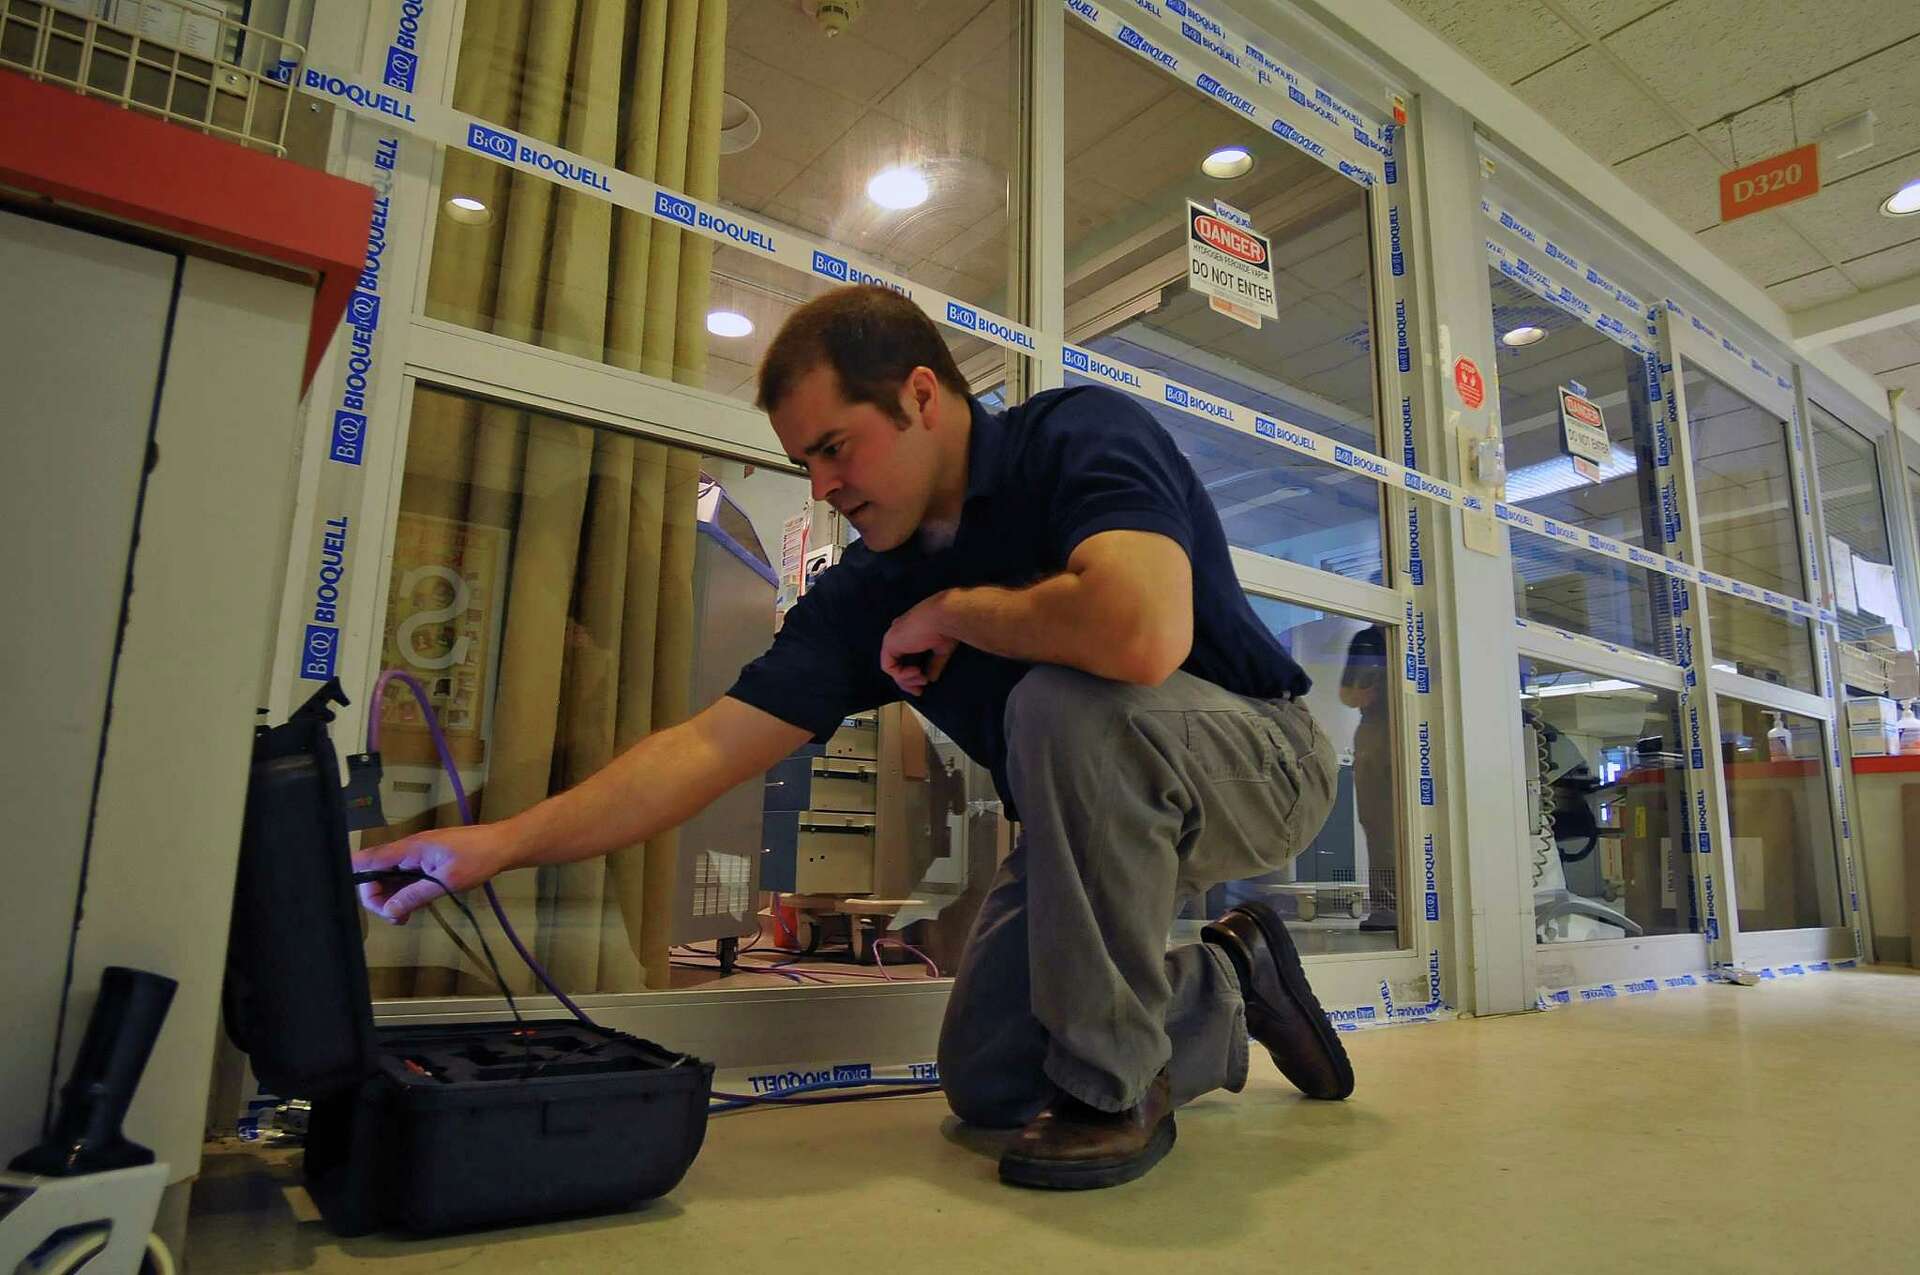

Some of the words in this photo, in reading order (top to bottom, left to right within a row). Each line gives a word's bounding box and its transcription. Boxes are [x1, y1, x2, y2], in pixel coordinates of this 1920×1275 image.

[396, 0, 425, 51] BIOQ
[1202, 37, 1241, 68] BIOQUELL
[306, 68, 417, 123] BIOQUELL
[1217, 85, 1257, 117] BIOQUELL
[1290, 126, 1326, 158] BIOQUELL
[520, 145, 613, 193] BIOQUELL
[1733, 163, 1802, 203] D320
[699, 211, 776, 253] BIOQUELL
[1199, 217, 1261, 261] DANGER
[1192, 258, 1209, 279] DO
[1211, 266, 1234, 289] NOT
[1238, 278, 1273, 304] ENTER
[979, 318, 1036, 351] BIOQUELL
[343, 322, 377, 411] BIOQUE
[1090, 360, 1141, 388] BIOQUELL
[1189, 396, 1235, 422] BIOQUELL
[1277, 427, 1317, 452] BIOQUELL
[1354, 456, 1389, 478] BIOQUELL
[1409, 507, 1420, 559] BIOQUELL
[315, 516, 348, 623] BIOQUELL
[1406, 600, 1414, 654] BIOQUELL
[1416, 611, 1425, 665] BIOQUELL
[1420, 720, 1429, 777] BIOQUELL
[1697, 789, 1707, 832] BIOQUELL
[1424, 833, 1433, 891] BIOQUELL
[747, 1071, 830, 1093] BIOQUELL
